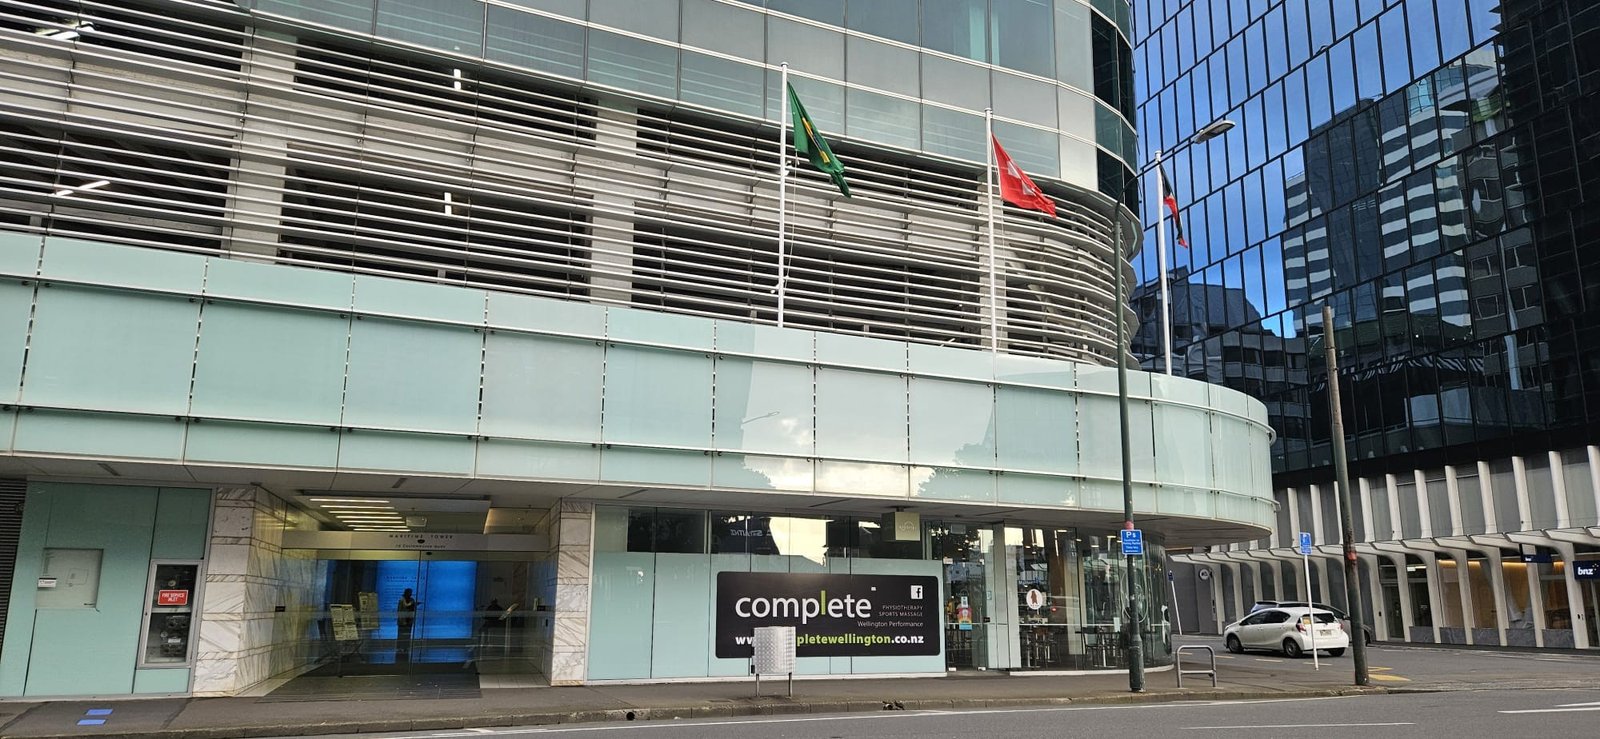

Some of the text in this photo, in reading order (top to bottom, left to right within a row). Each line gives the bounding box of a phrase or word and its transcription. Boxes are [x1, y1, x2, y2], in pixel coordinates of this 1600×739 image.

[1577, 567, 1593, 575] bnz
[735, 590, 872, 625] complete
[857, 620, 888, 628] Wellington
